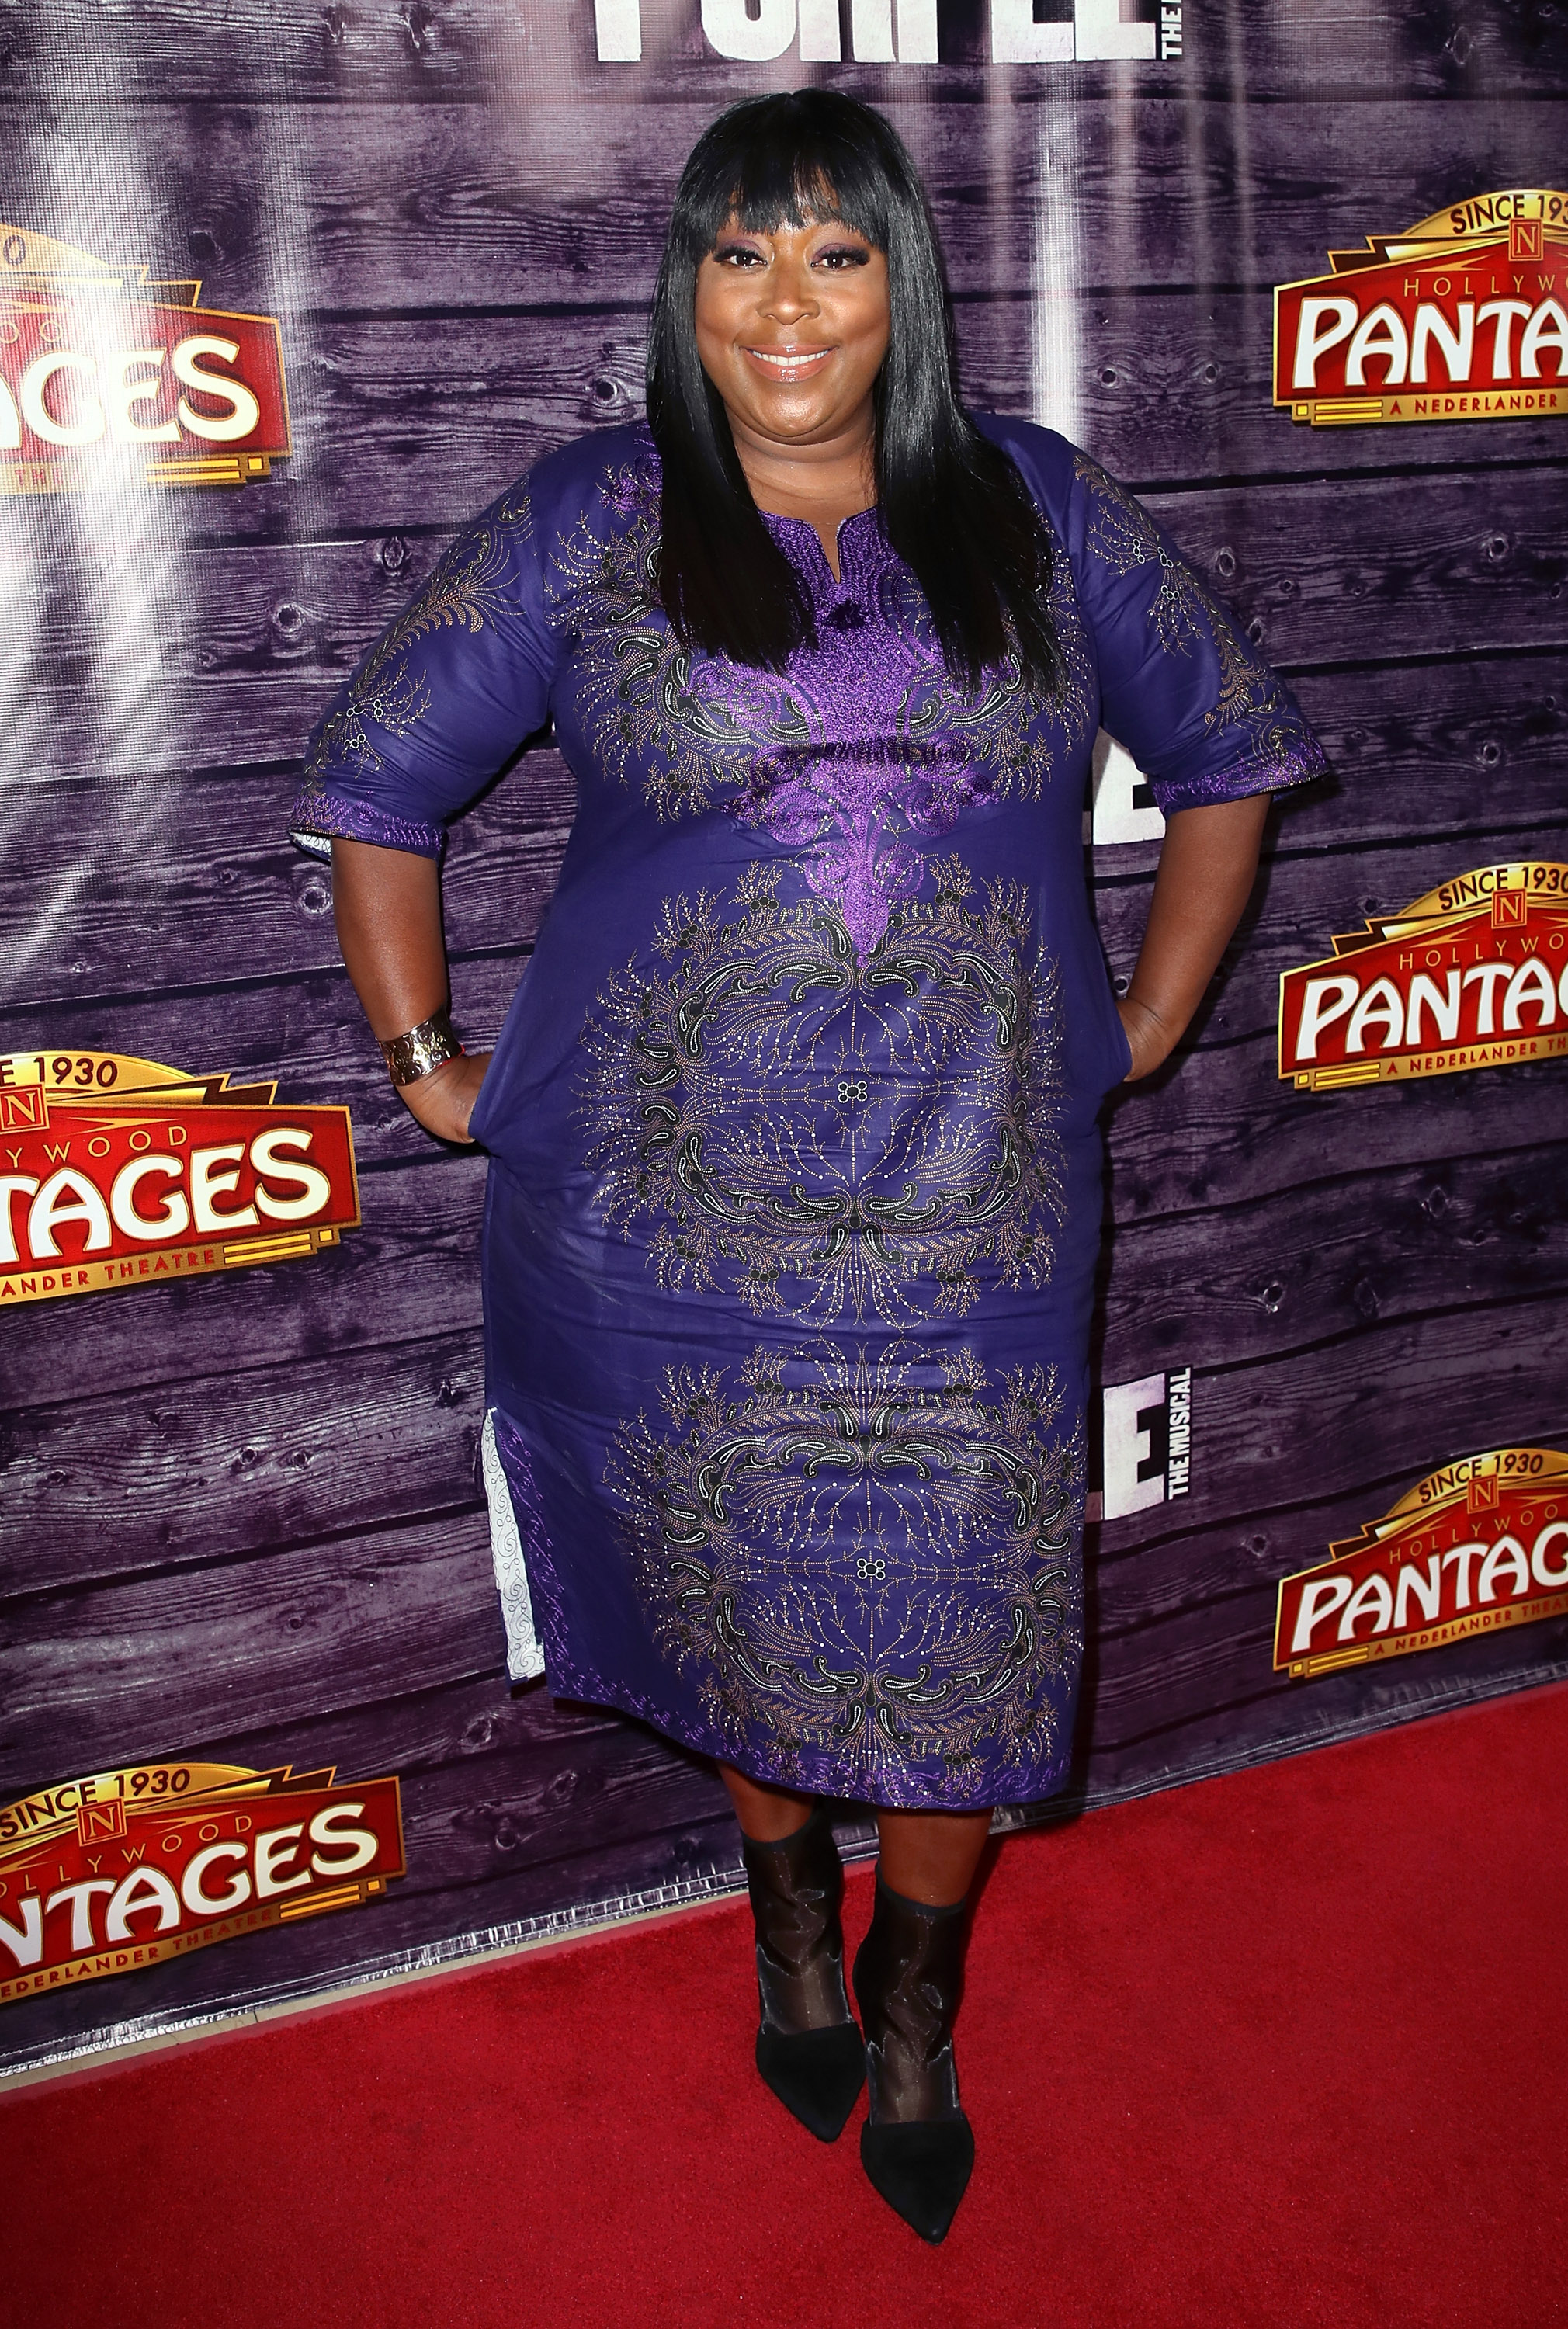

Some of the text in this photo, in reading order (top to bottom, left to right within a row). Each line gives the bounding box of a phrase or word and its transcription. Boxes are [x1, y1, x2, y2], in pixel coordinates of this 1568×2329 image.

[1451, 195, 1525, 234] SINCE
[1516, 226, 1536, 254] N
[1404, 274, 1568, 297] HOLLYW
[1292, 297, 1568, 389] PANTA
[1389, 394, 1558, 415] A NEDERLANDER
[1438, 869, 1509, 911] SINCE
[1499, 895, 1521, 922] N
[1400, 933, 1564, 970] HOLLYWO
[1295, 956, 1568, 1061] PANTA
[33, 1057, 118, 1088] 1930
[1386, 1060, 1398, 1075] A
[1410, 1041, 1538, 1072] NEDERLANDER
[4, 1092, 36, 1126] N
[6, 1126, 187, 1168] YWOOD
[1, 1249, 216, 1297] ANDER THEATRE
[1086, 1372, 1165, 1520] E
[1168, 1367, 1191, 1501] THE MUSICAL
[1418, 1453, 1543, 1504] SINCE 1930
[1473, 1481, 1493, 1507] N
[1389, 1504, 1559, 1565] HOLLYWOO
[1374, 1643, 1386, 1657] A
[1395, 1610, 1512, 1650] NEDERLANDER
[0, 1768, 190, 1838] SINCE 1930
[87, 1807, 116, 1838] N
[1, 1909, 271, 1998] EDERLANDER THEATRE
